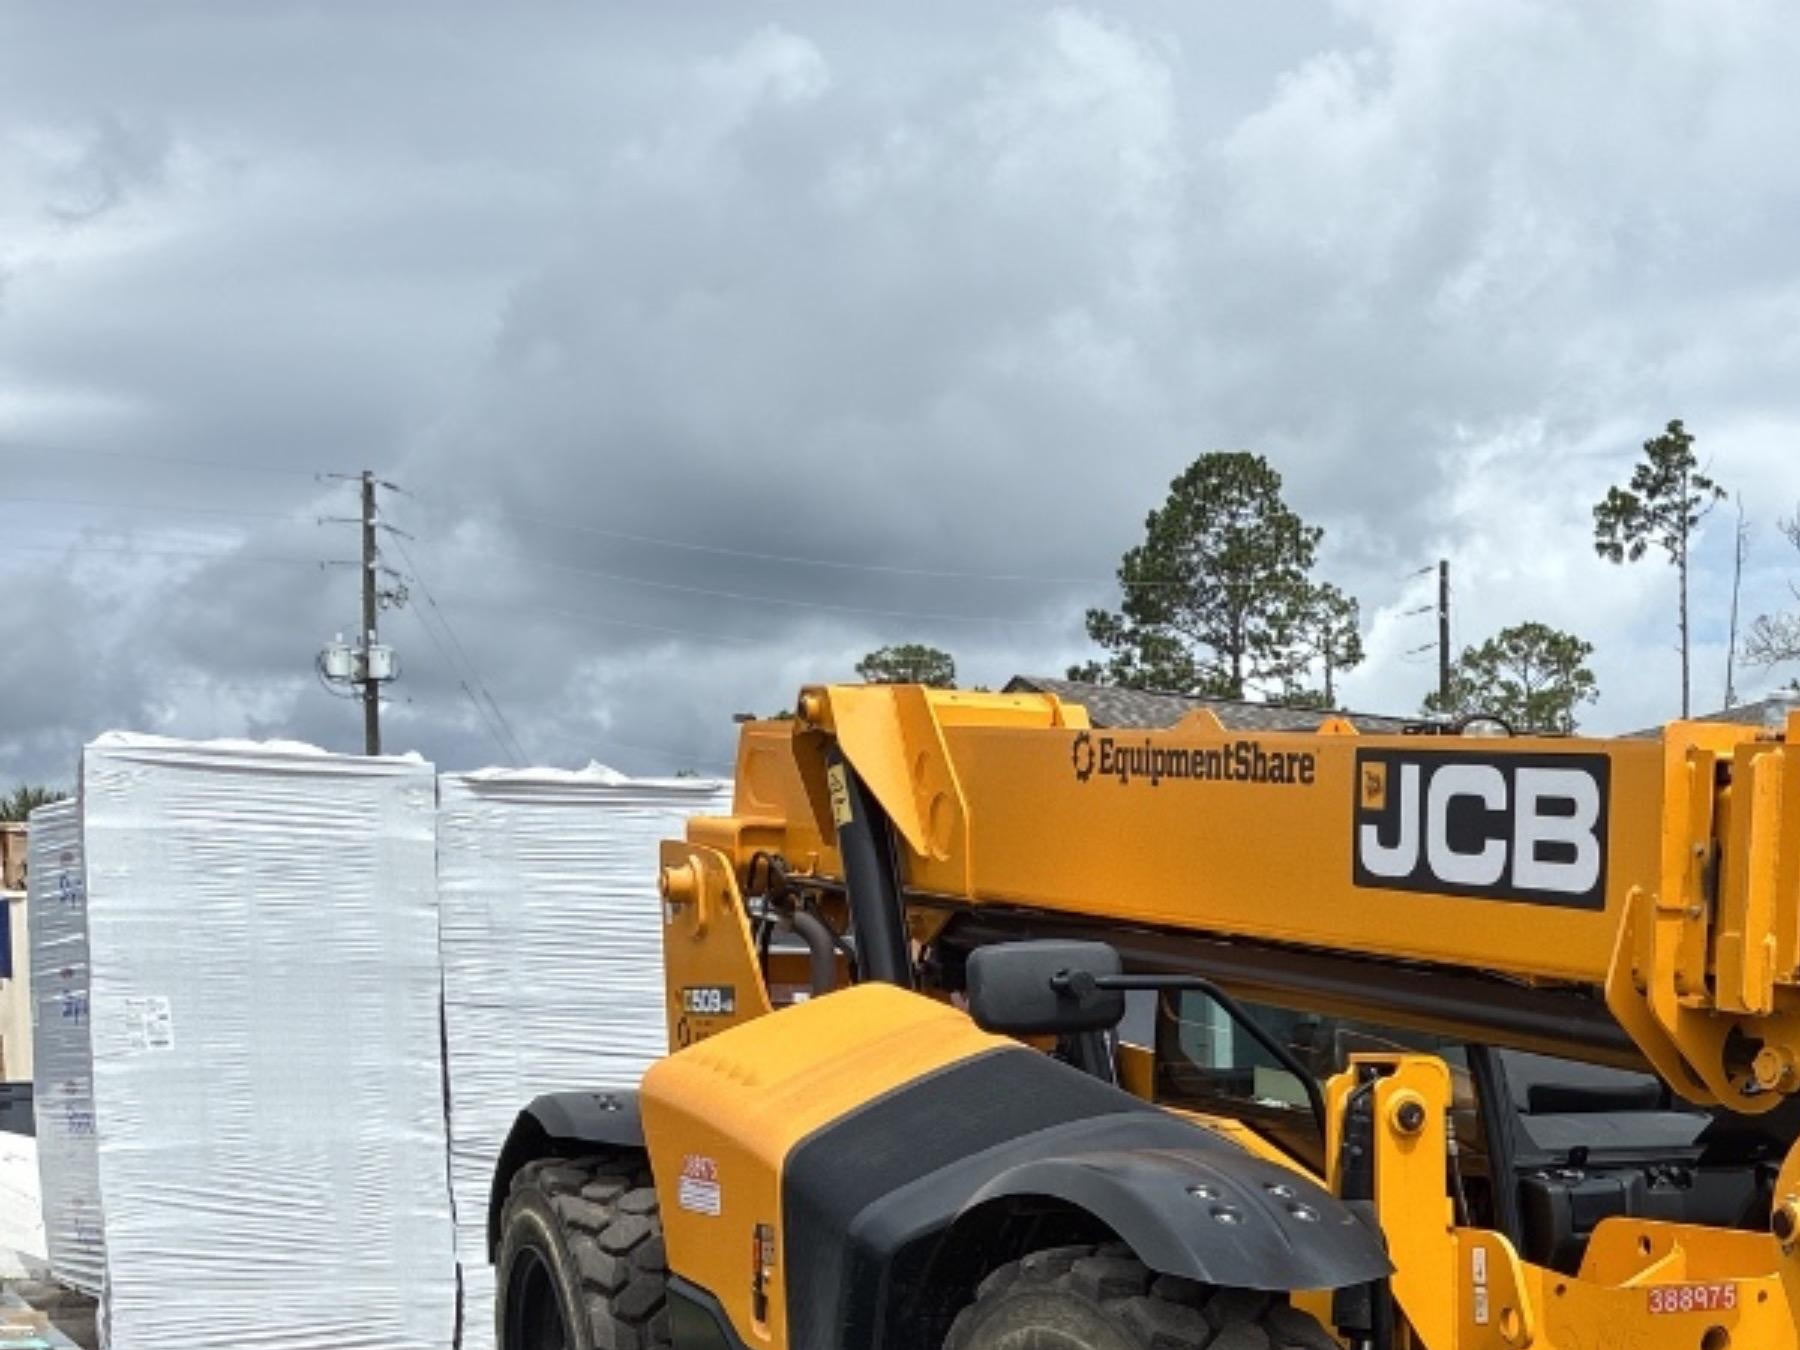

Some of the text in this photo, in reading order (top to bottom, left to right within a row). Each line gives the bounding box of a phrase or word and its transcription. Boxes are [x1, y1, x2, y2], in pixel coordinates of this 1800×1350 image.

[1098, 737, 1316, 787] EquipmentShare
[1360, 762, 1601, 896] JCB
[1649, 1283, 1736, 1313] 388975
